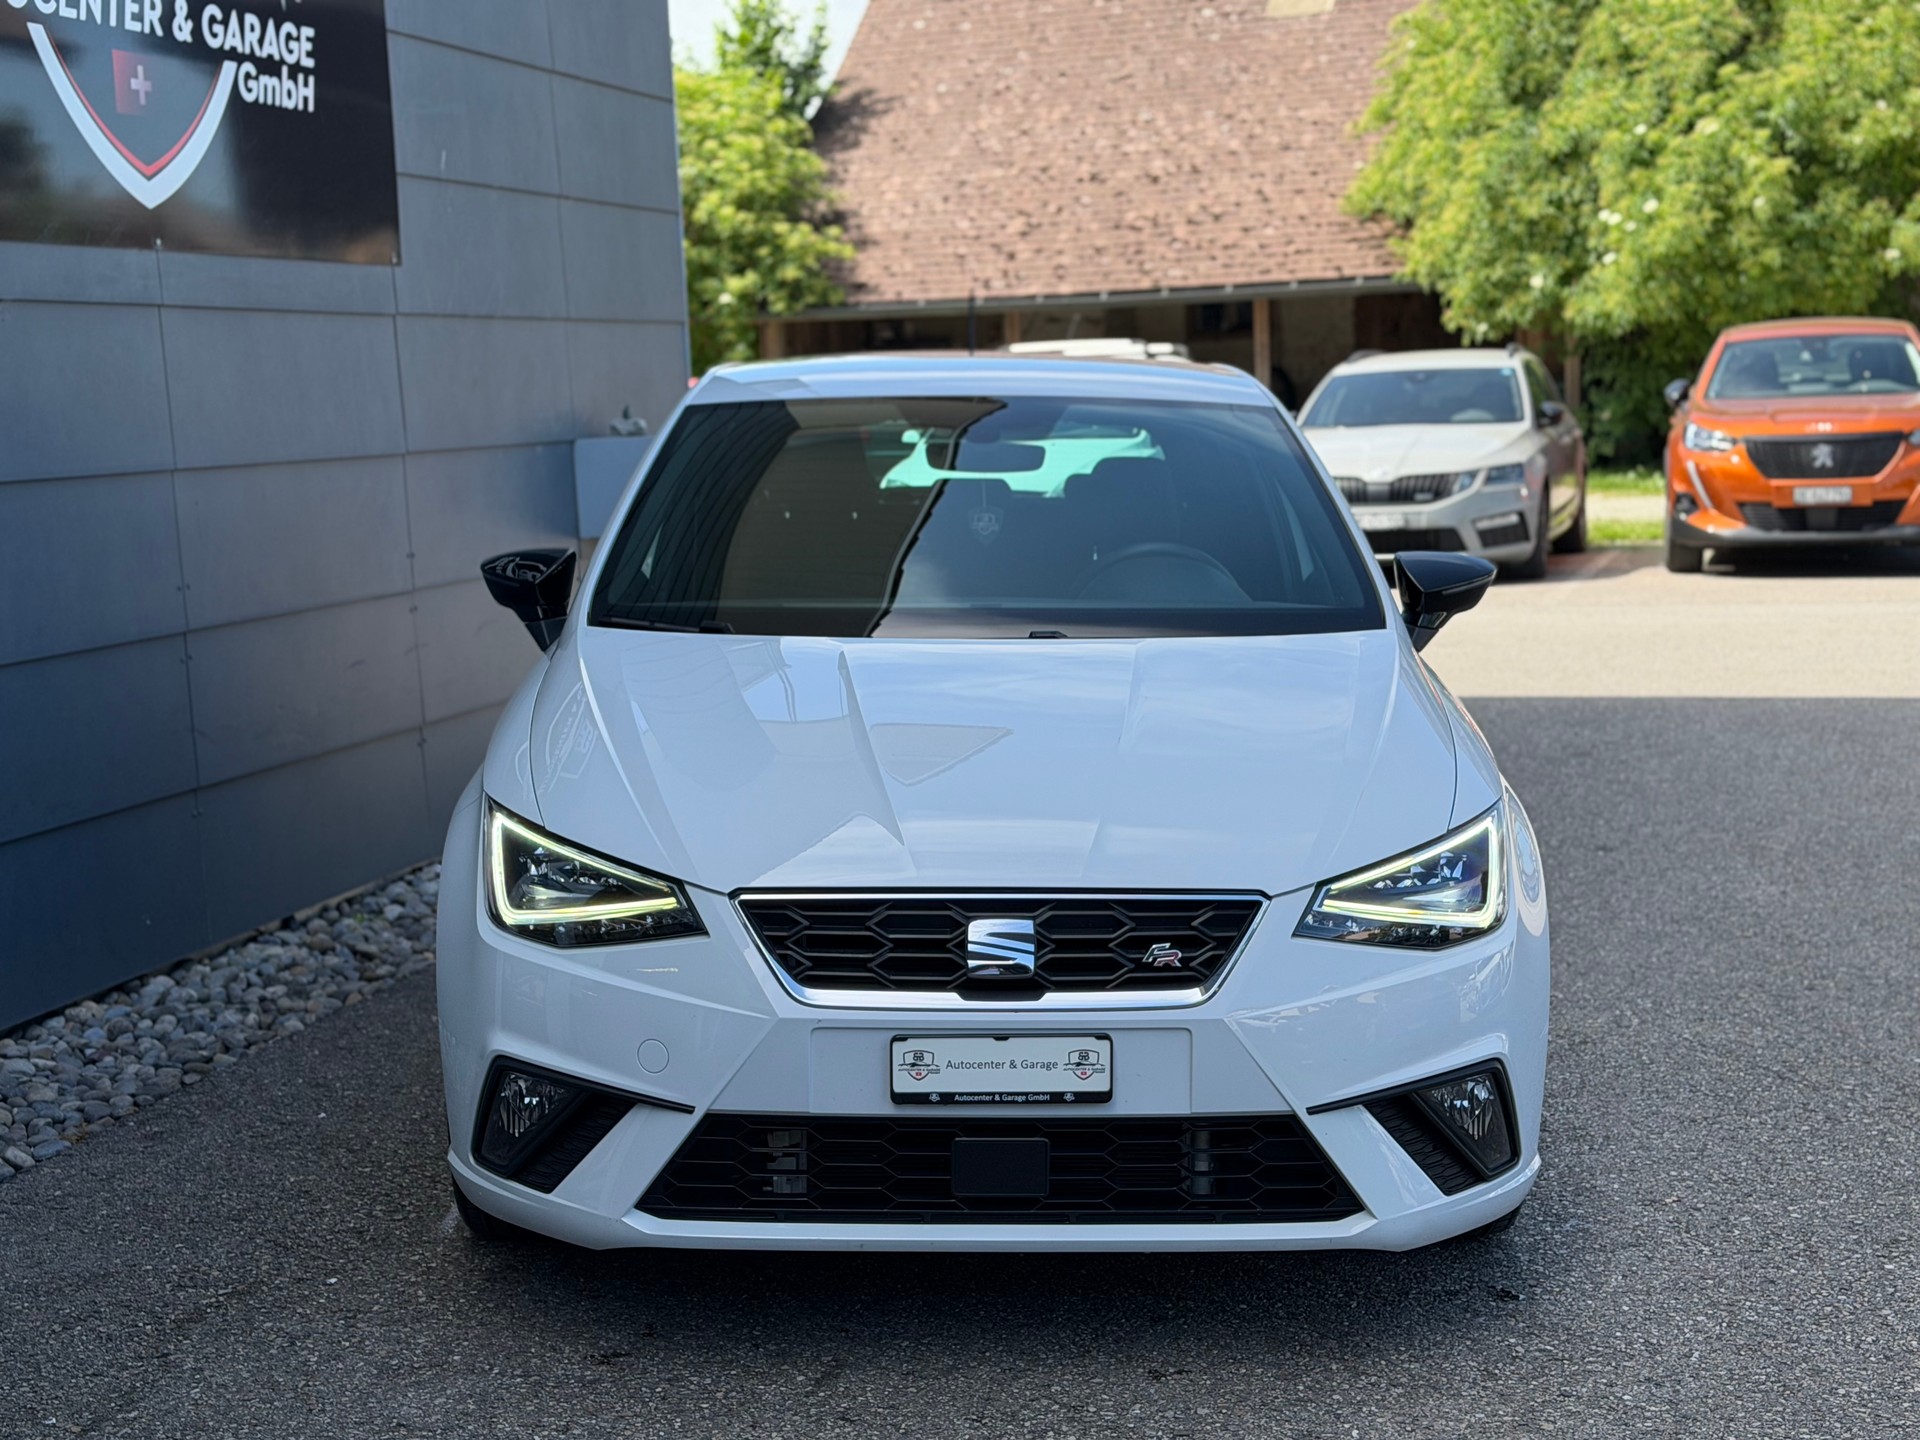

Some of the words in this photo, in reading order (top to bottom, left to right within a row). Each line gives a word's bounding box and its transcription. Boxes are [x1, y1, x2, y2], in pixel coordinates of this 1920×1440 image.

[6, 0, 164, 37] NTER
[171, 0, 194, 43] &
[201, 3, 316, 69] GARAGE
[237, 61, 315, 113] GmbH
[1141, 942, 1182, 967] FR
[945, 1059, 1006, 1070] Autocenter
[1008, 1059, 1018, 1070] &
[1020, 1059, 1059, 1072] Garage
[1001, 1094, 1027, 1103] Garage
